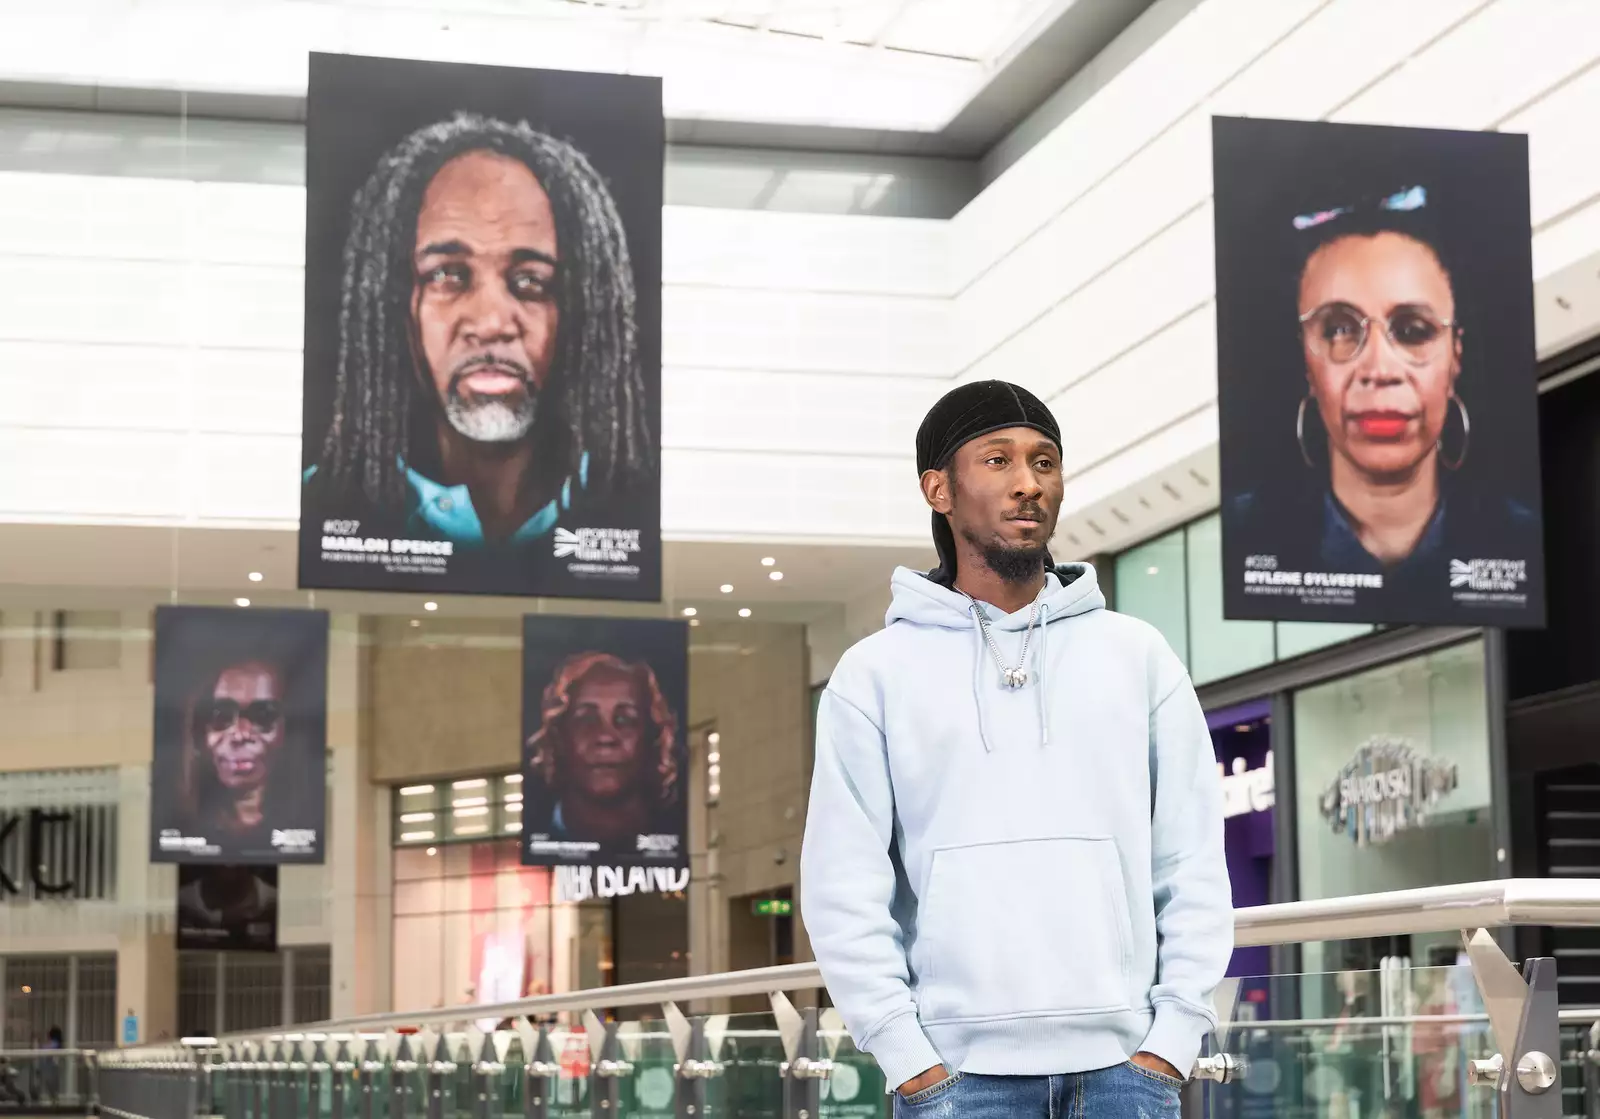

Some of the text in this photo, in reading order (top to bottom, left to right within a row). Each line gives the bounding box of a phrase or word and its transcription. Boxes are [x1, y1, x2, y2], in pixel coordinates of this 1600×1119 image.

[323, 519, 361, 536] #027
[583, 527, 640, 540] PORTRAIT
[321, 535, 454, 556] MARLON SPENCE
[600, 539, 641, 552] BLACK
[1475, 558, 1525, 570] PORTRAIT
[1244, 570, 1383, 588] MYLENE SYLVESTRE
[1491, 569, 1527, 582] BLACK
